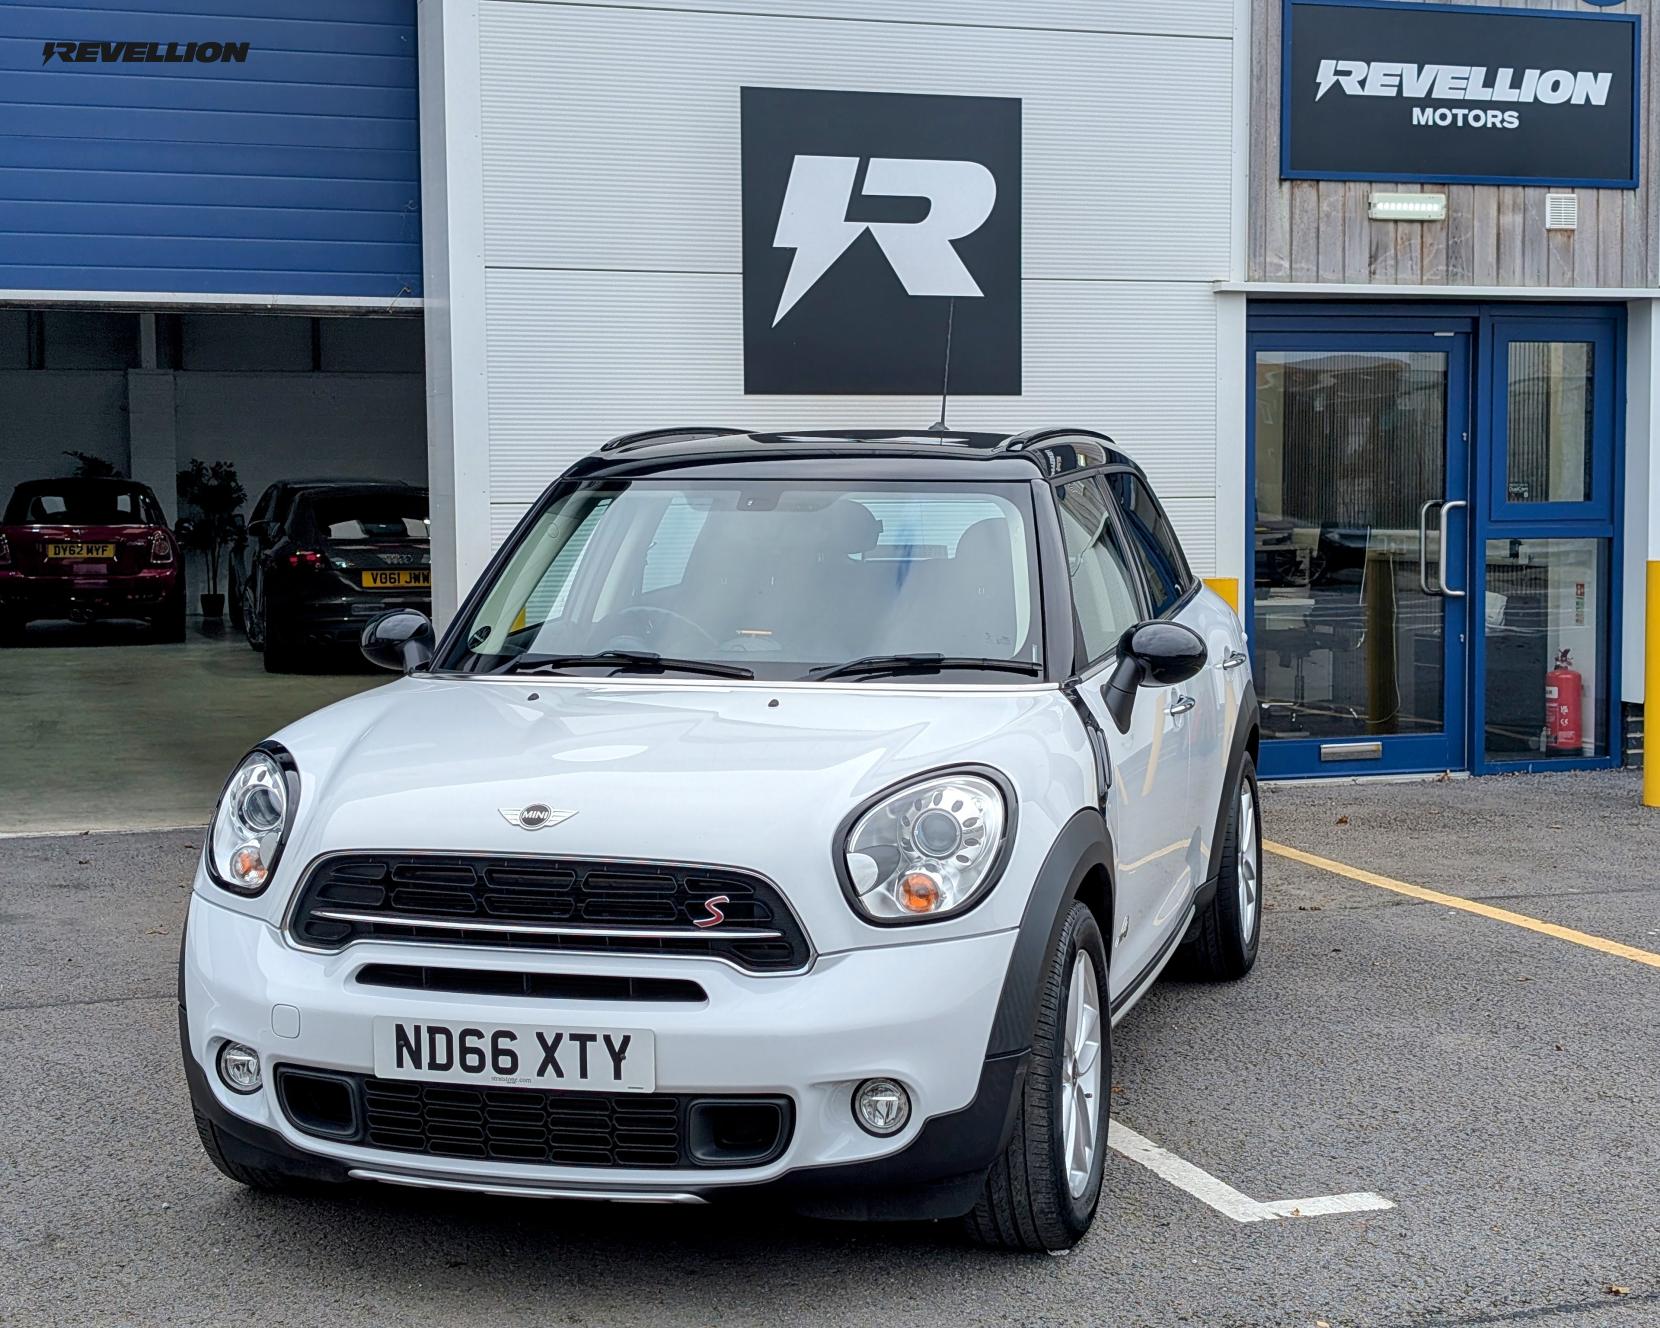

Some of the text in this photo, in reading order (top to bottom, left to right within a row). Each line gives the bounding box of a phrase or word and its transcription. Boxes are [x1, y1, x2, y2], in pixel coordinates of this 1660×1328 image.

[1315, 59, 1613, 106] REVELLION
[1412, 107, 1520, 129] MOTORS
[771, 154, 997, 329] R
[54, 545, 83, 556] DY62
[522, 810, 549, 819] MINI
[693, 895, 730, 928] S
[395, 1023, 632, 1081] ND66 XTY
